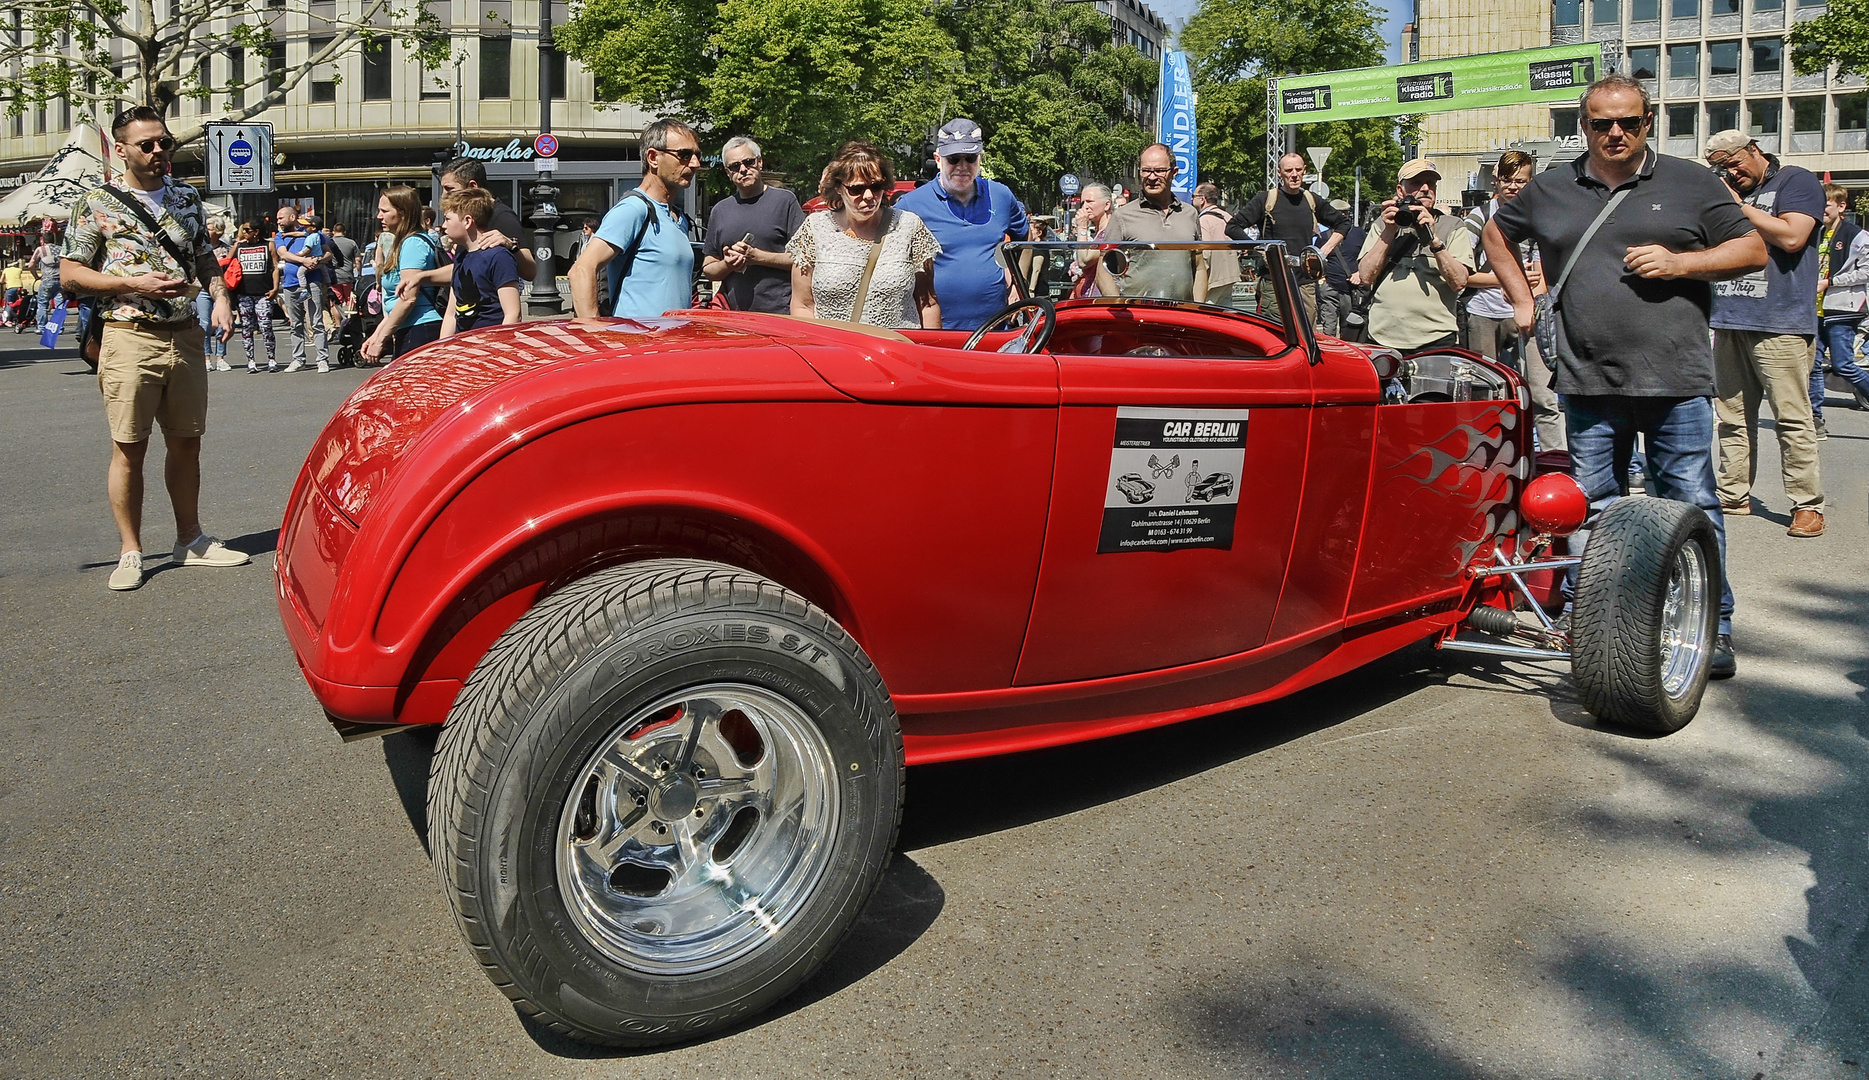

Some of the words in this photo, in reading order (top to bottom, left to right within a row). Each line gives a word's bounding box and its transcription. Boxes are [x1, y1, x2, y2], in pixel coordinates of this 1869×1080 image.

[1545, 77, 1572, 86] radio
[1410, 90, 1434, 99] radio
[1461, 83, 1523, 95] www.klassikradio.de
[1337, 96, 1391, 106] www.klassikradio.de
[452, 138, 534, 163] Douglas
[15, 172, 24, 187] of
[240, 253, 266, 262] STREET
[242, 262, 264, 270] WEAR
[1731, 280, 1756, 294] Trip
[1163, 421, 1192, 437] CAR
[1194, 422, 1240, 437] BERLIN
[1131, 519, 1173, 528] Dahlmannstrasse
[1119, 538, 1168, 548] info@carberlin.com
[1170, 536, 1215, 545] www.carberlin.com
[610, 623, 770, 678] PROXES
[778, 633, 829, 664] S/T
